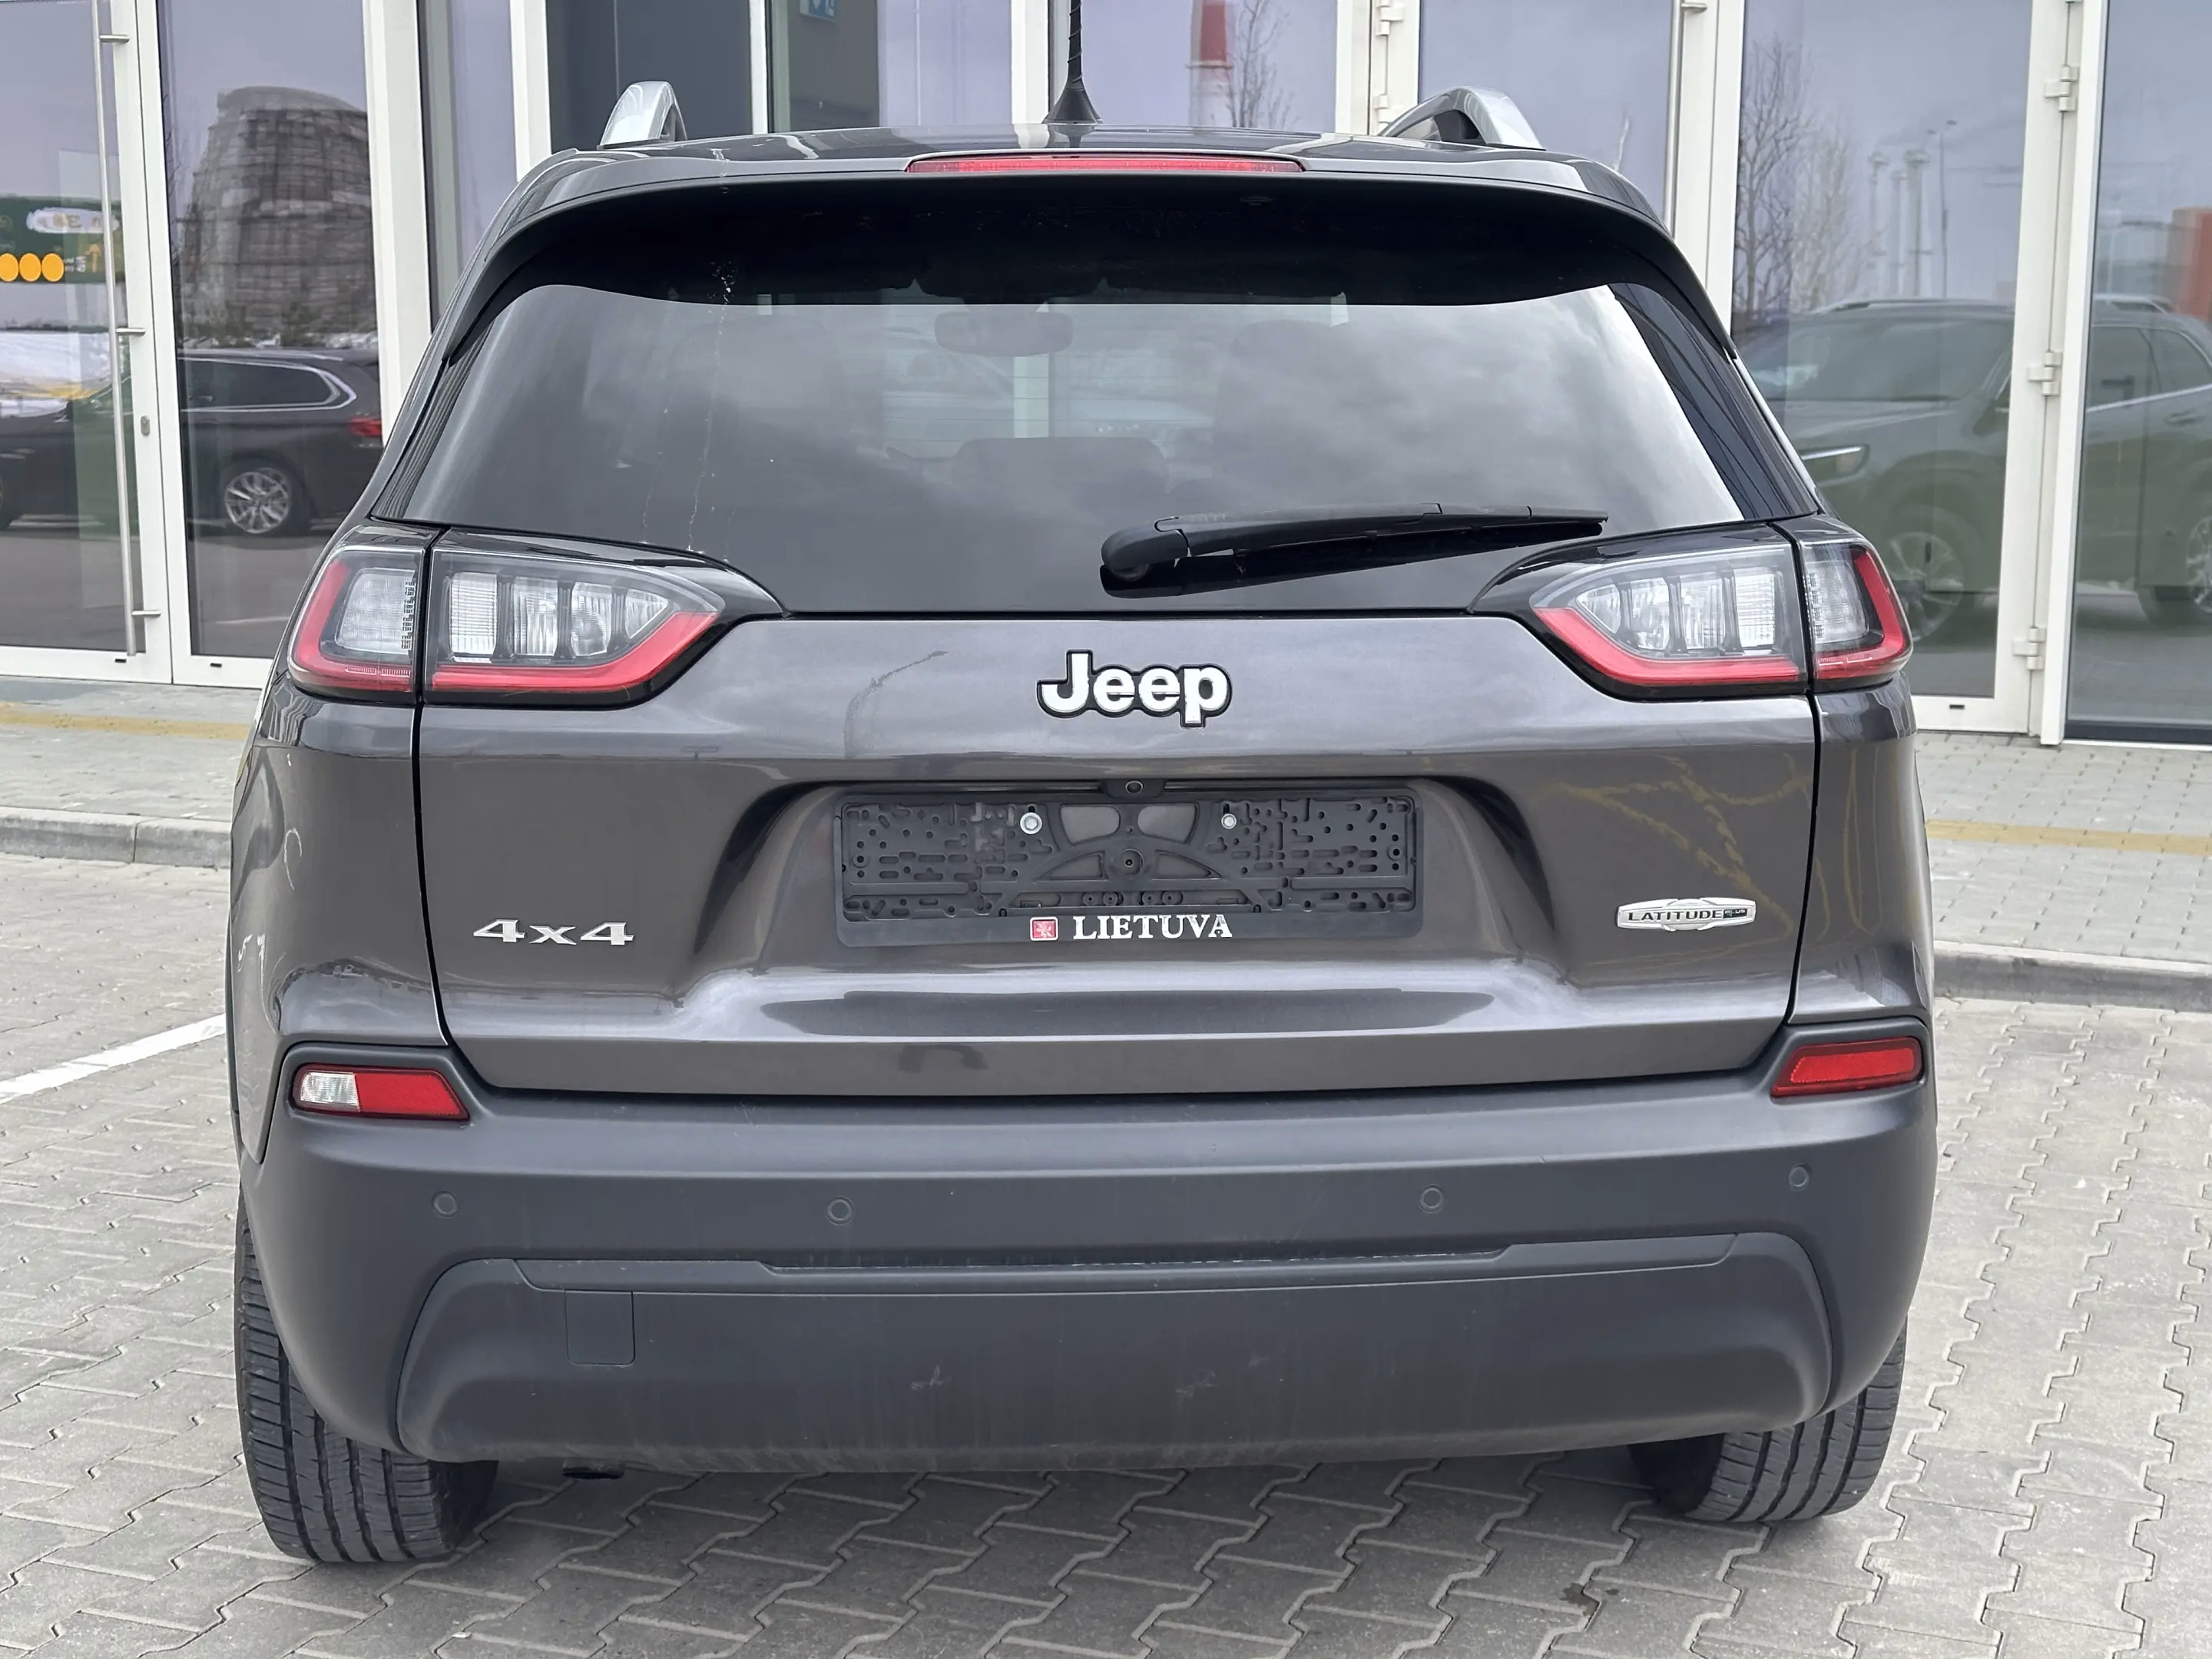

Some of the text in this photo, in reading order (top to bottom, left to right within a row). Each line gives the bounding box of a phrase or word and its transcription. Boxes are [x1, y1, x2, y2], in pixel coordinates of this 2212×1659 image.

[1041, 652, 1229, 724] Jeep
[1073, 914, 1233, 940] LIETUVA
[1628, 909, 1724, 922] LATITUDE
[473, 919, 634, 945] 4x4
